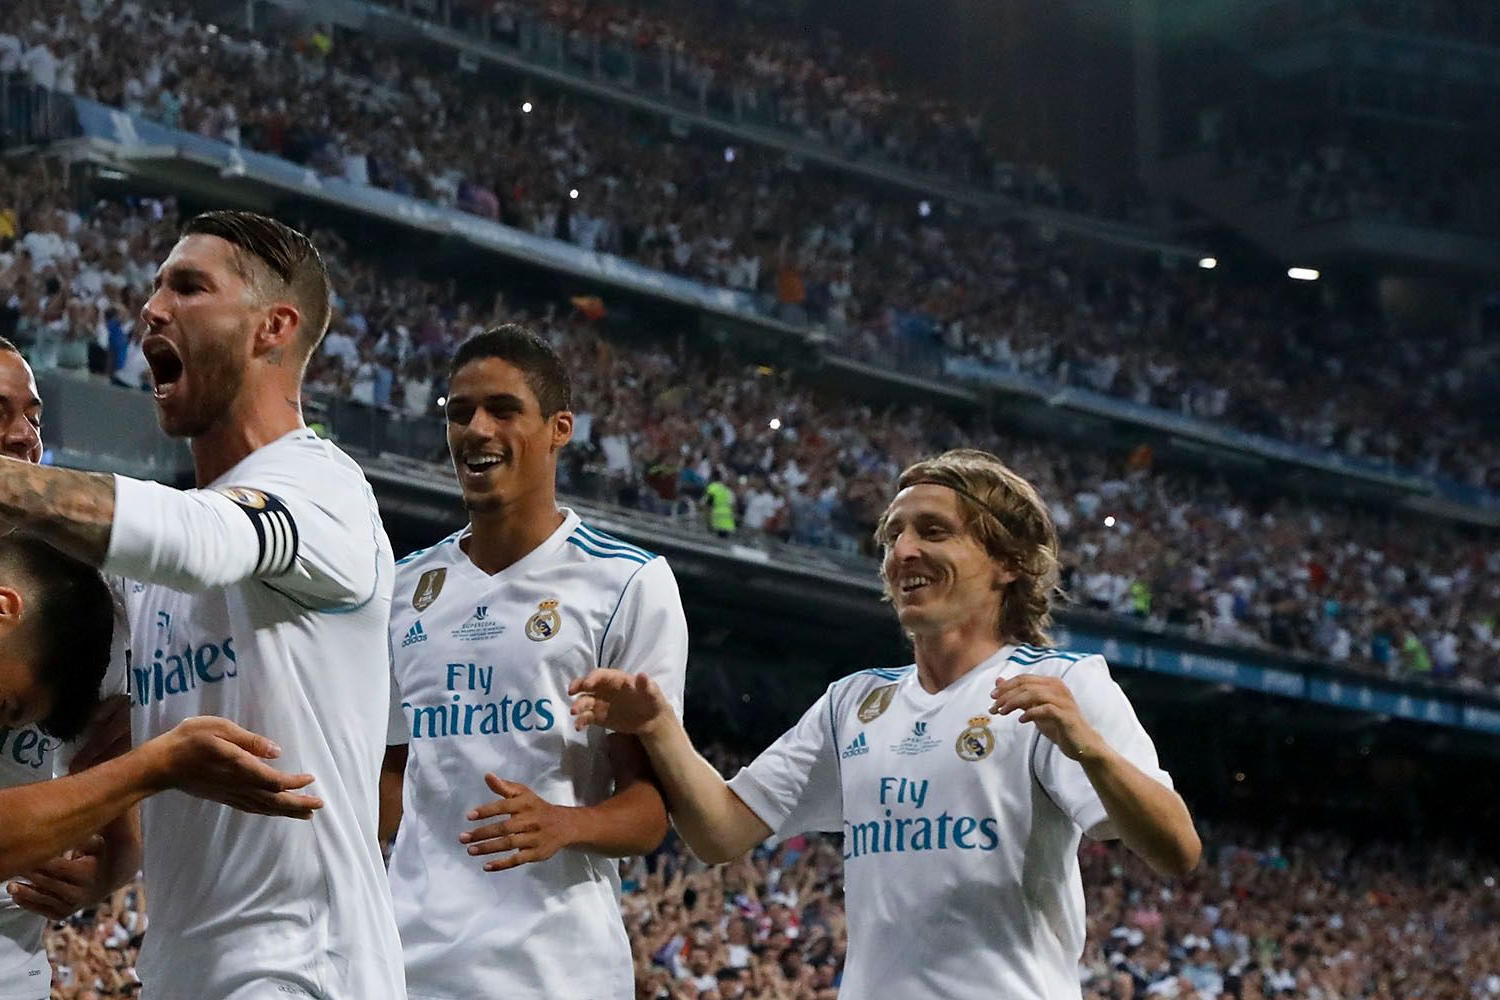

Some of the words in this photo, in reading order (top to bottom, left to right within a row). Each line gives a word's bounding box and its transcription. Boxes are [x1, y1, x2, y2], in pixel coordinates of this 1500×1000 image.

[401, 633, 428, 648] adidas
[446, 663, 493, 695] Fly
[879, 777, 928, 808] Fly
